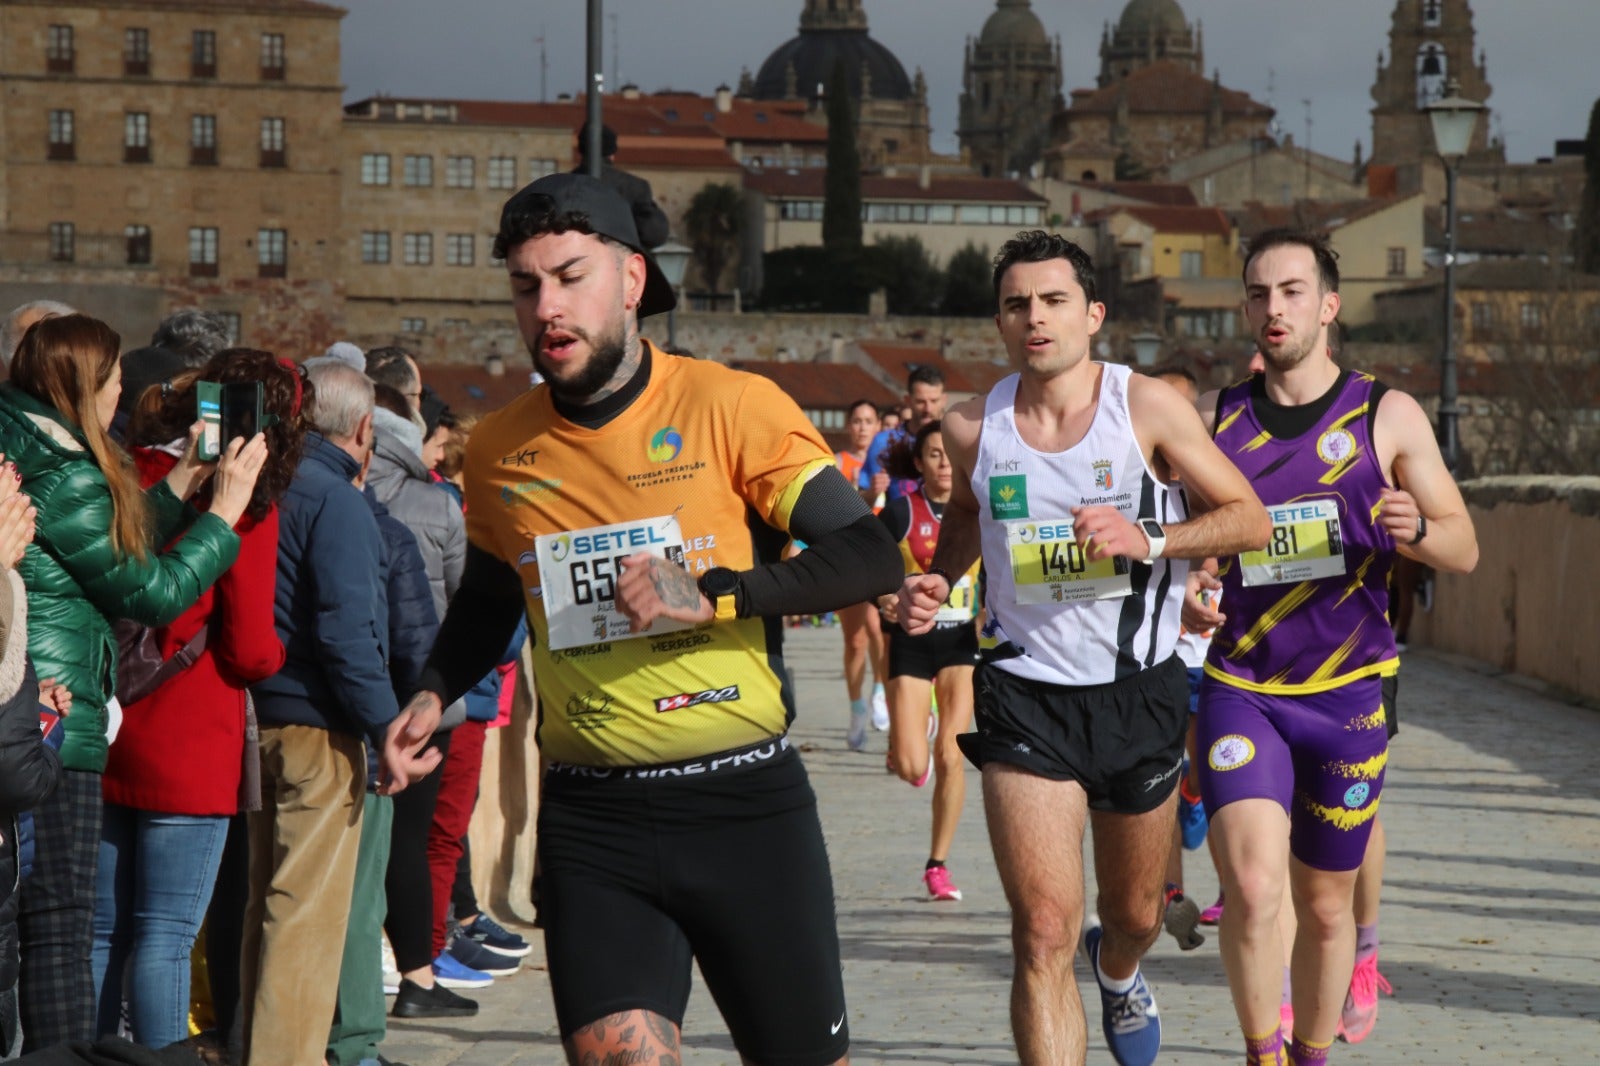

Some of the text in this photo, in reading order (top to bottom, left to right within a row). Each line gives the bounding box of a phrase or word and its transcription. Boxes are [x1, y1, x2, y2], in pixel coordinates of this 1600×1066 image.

[502, 449, 540, 467] EKT
[627, 470, 662, 481] ESCUELA
[1080, 493, 1132, 505] Ayuntamiento
[573, 526, 666, 555] SETEL
[682, 535, 717, 554] UEZ
[1039, 542, 1086, 576] 140
[1043, 574, 1072, 583] CARLOS
